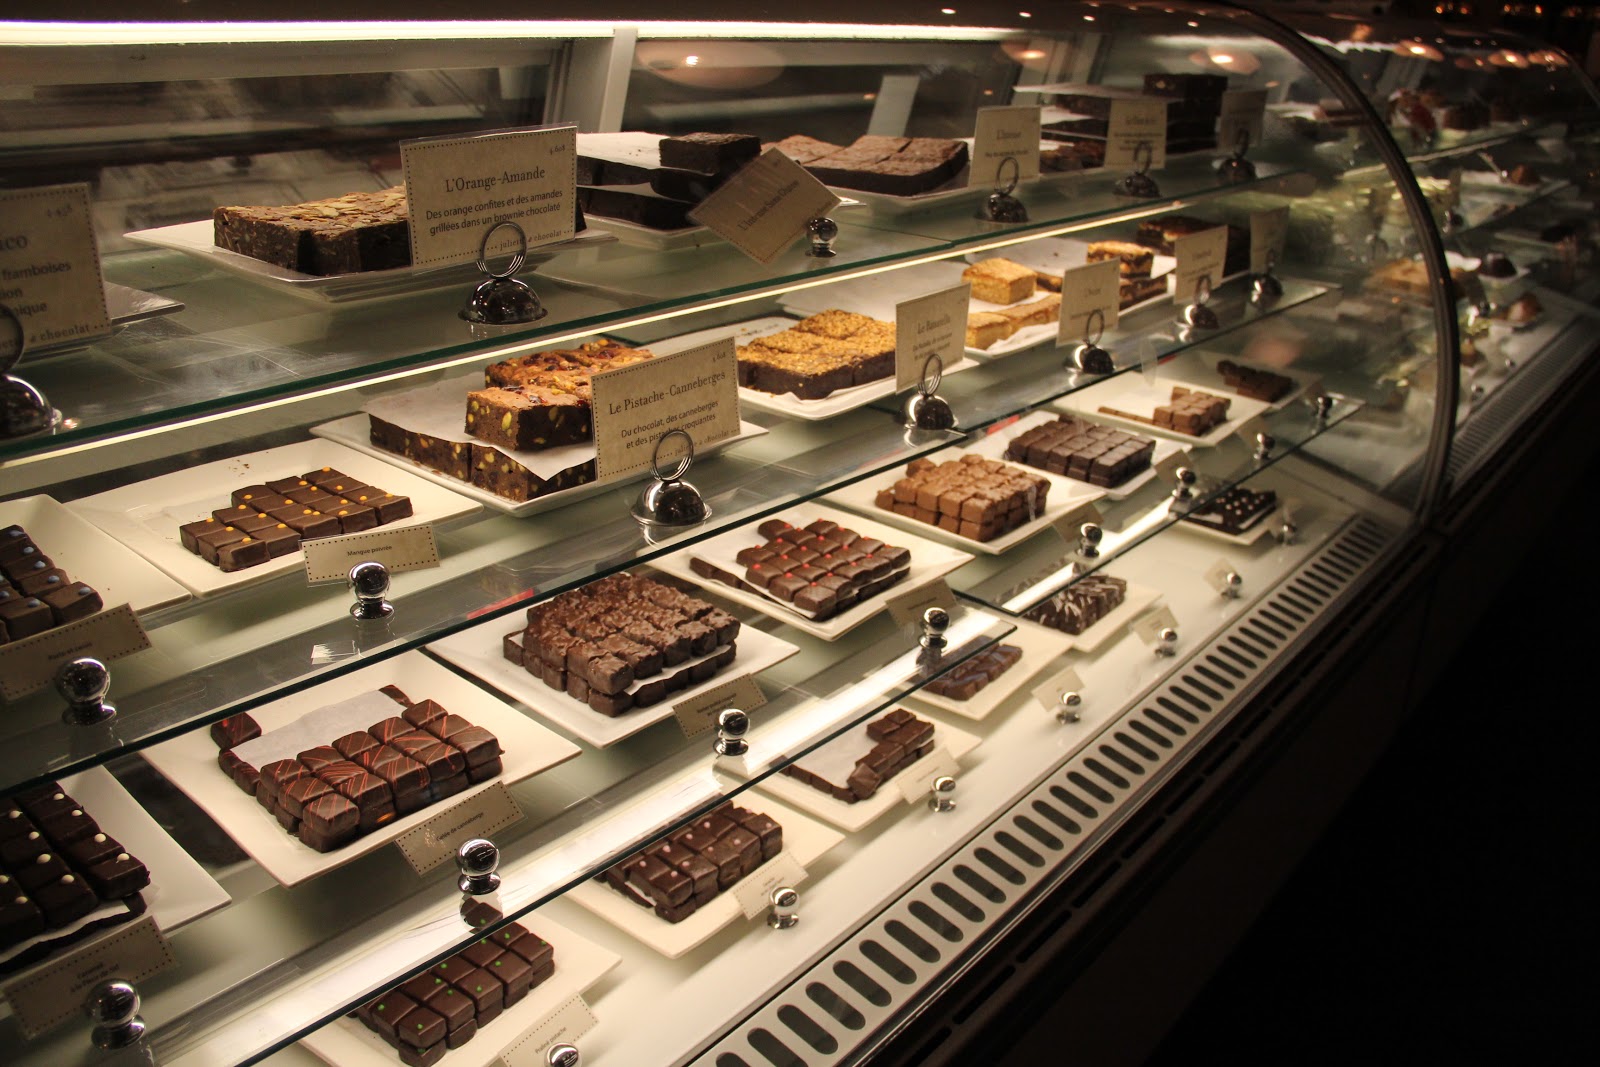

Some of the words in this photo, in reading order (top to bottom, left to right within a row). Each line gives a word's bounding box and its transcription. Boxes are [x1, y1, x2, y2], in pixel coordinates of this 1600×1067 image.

[445, 166, 546, 193] L'Orange-Amande
[425, 210, 442, 220] Des
[443, 205, 473, 217] orange
[474, 199, 506, 212] confites
[506, 197, 515, 206] et
[516, 194, 529, 204] des
[530, 189, 563, 202] amandes
[429, 222, 460, 236] grillées
[461, 217, 481, 229] dans
[481, 215, 493, 225] un
[494, 209, 525, 222] brownie
[525, 202, 561, 217] chocolaté
[534, 229, 562, 242] chocolat
[40, 323, 91, 341] chocolat
[608, 403, 622, 416] Le
[624, 370, 727, 411] Pistache-Canneberges
[621, 429, 632, 439] Du
[633, 419, 665, 435] chocolat,
[665, 414, 678, 424] des
[678, 400, 719, 420] canneberges
[626, 441, 634, 449] et
[635, 436, 648, 447] des
[681, 413, 716, 431] croquantes
[347, 548, 371, 557] Mangue
